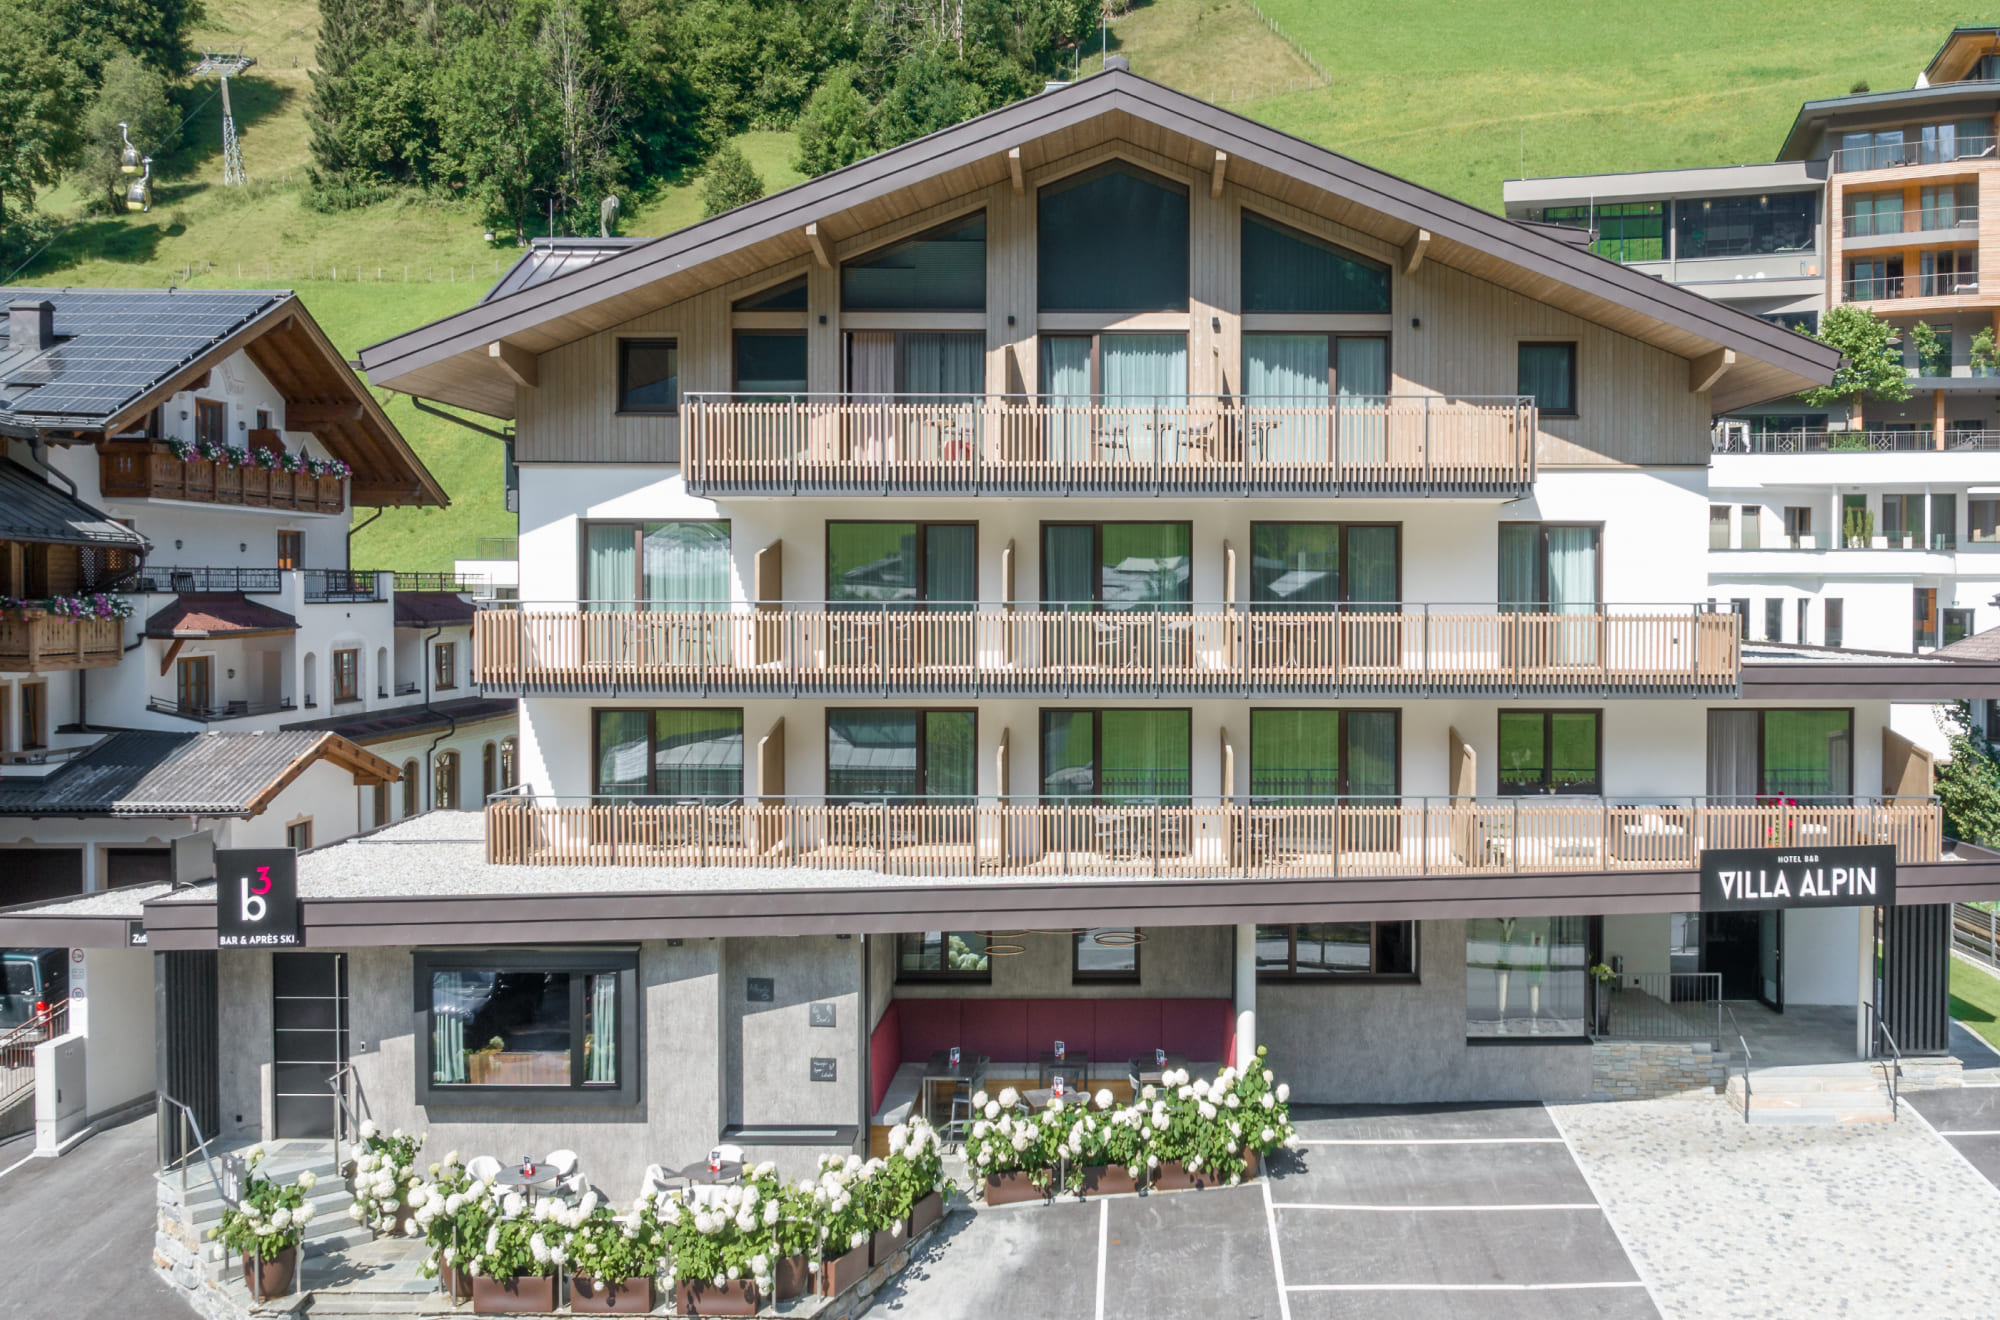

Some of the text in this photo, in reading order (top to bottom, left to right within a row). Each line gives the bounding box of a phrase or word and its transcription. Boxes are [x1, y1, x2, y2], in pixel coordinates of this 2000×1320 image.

[1777, 855, 1802, 863] HOTEL
[1718, 867, 1877, 900] VILLA ALPIN
[220, 933, 295, 945] BAR & APRÈS SKI
